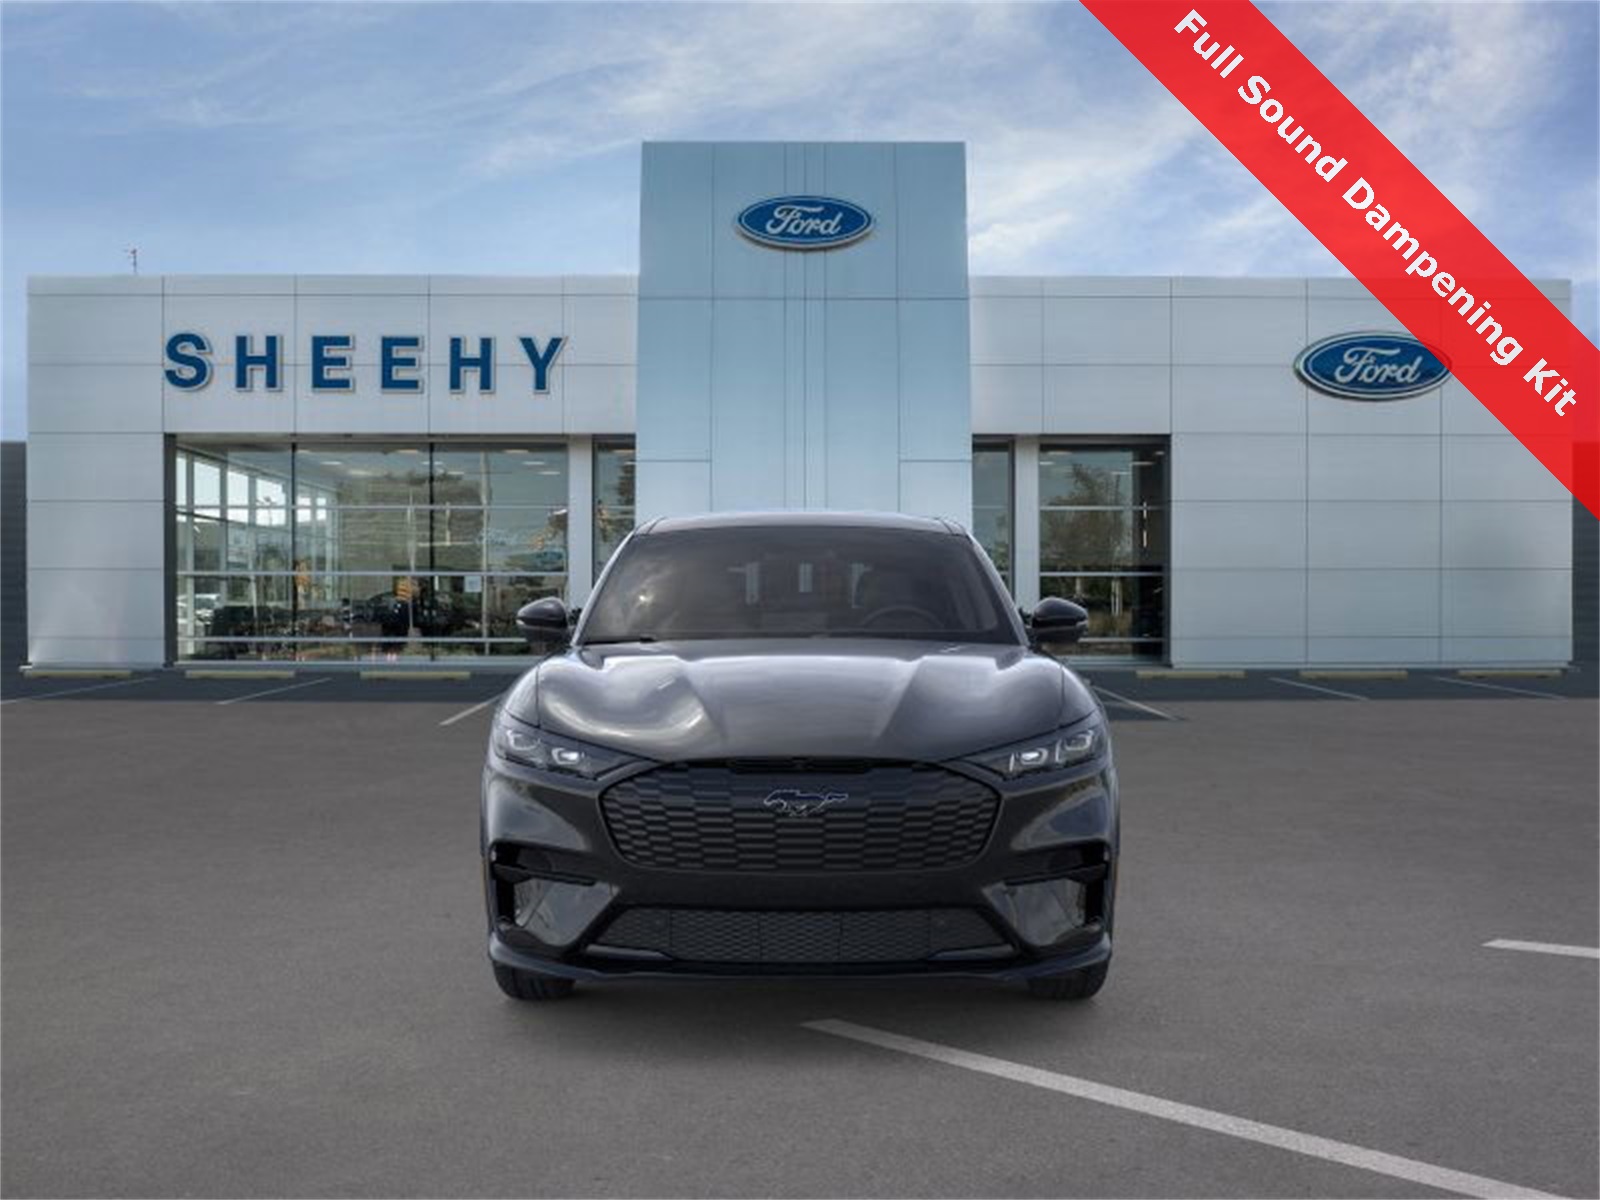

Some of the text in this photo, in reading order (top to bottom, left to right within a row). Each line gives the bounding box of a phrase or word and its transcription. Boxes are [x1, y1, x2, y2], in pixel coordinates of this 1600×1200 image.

[765, 204, 843, 235] Ford
[163, 332, 567, 394] SHEEHY
[1334, 346, 1423, 383] Ford
